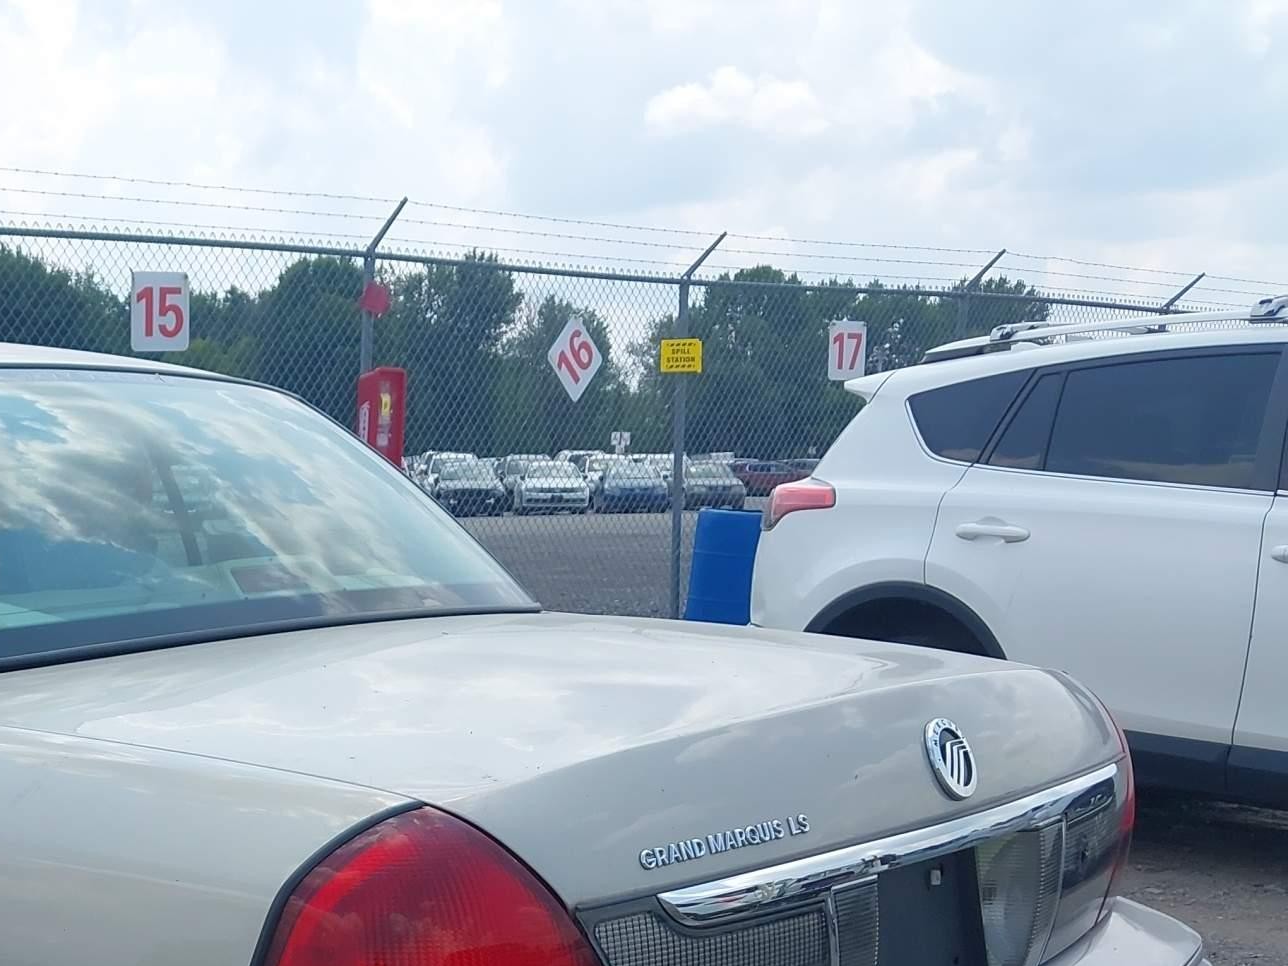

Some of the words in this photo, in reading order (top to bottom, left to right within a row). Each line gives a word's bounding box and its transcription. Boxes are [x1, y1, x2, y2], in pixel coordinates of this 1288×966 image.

[136, 286, 184, 338] 15
[557, 329, 593, 385] 16
[833, 332, 863, 370] 17
[639, 837, 706, 871] GRAND
[706, 819, 785, 855] MARQUIS
[787, 814, 811, 836] LS
